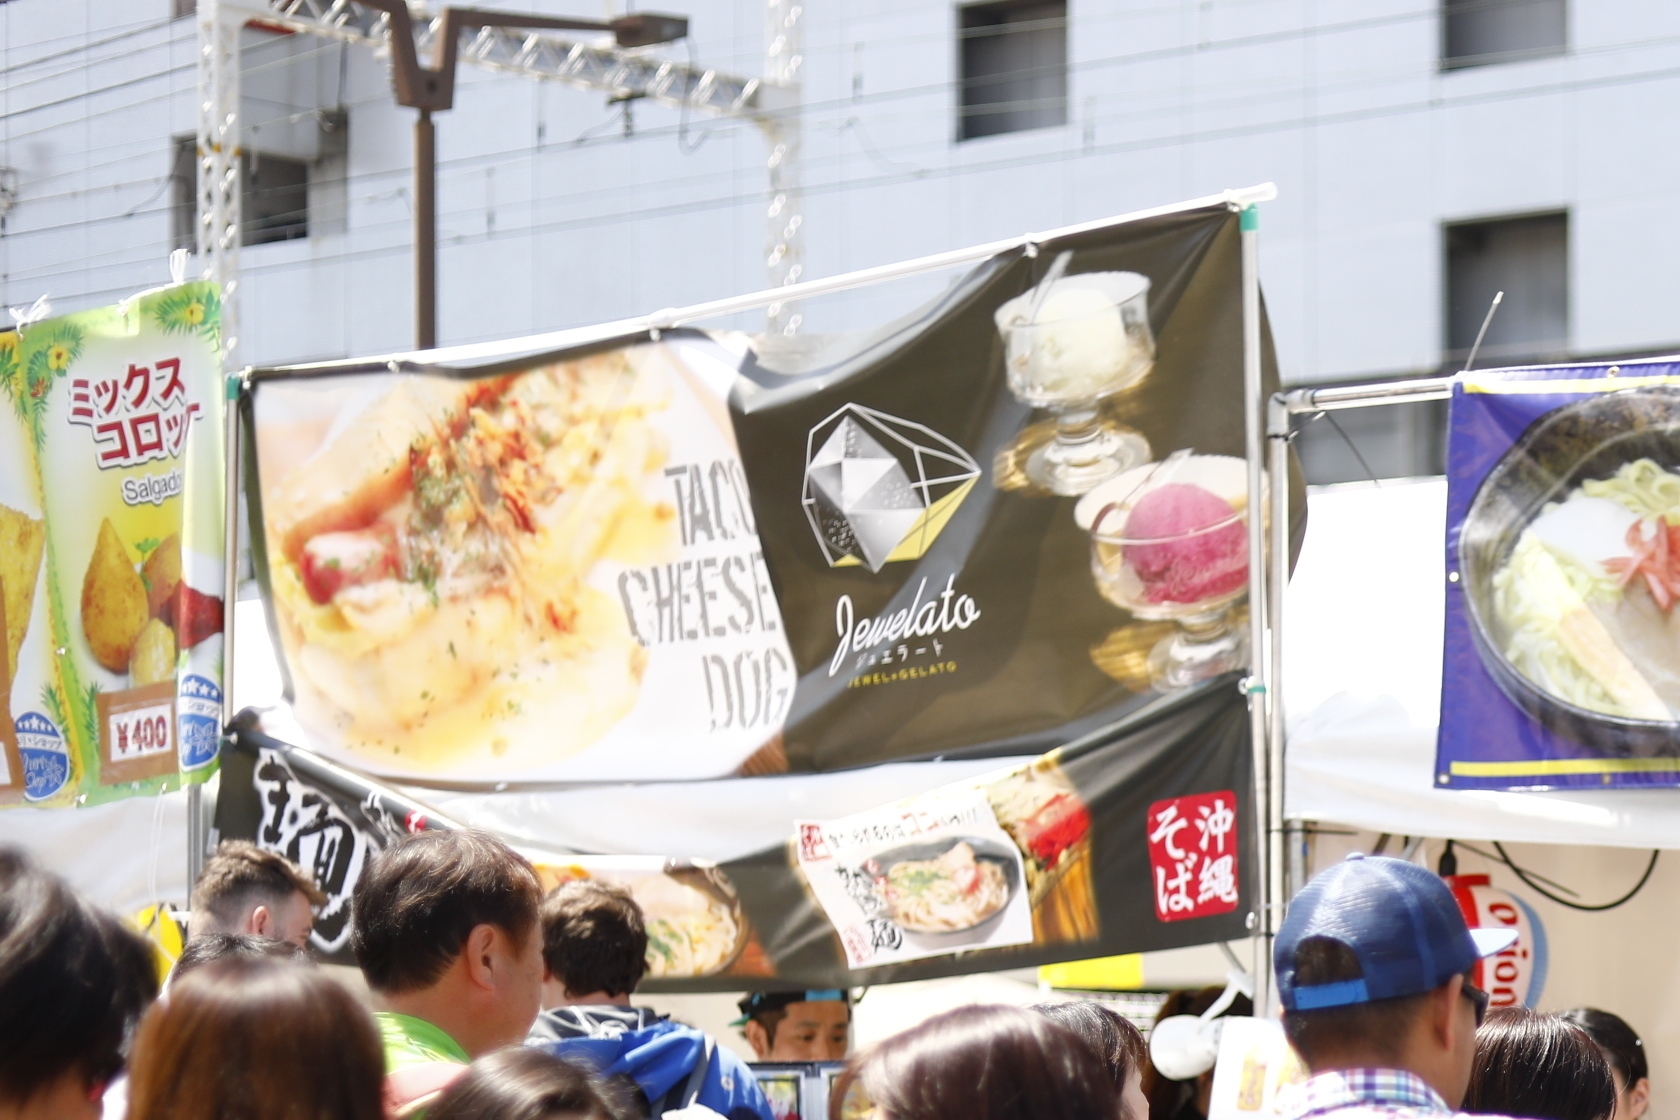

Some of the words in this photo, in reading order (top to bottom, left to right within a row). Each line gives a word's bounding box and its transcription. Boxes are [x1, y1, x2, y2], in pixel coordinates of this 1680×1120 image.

[71, 356, 186, 418] ミックス
[617, 552, 776, 647] CHEESE
[828, 572, 982, 678] Jewelato
[702, 648, 788, 735] DOG
[1150, 803, 1199, 916] そば
[1194, 798, 1239, 905] 沖縄
[1487, 902, 1529, 1007] Oion
